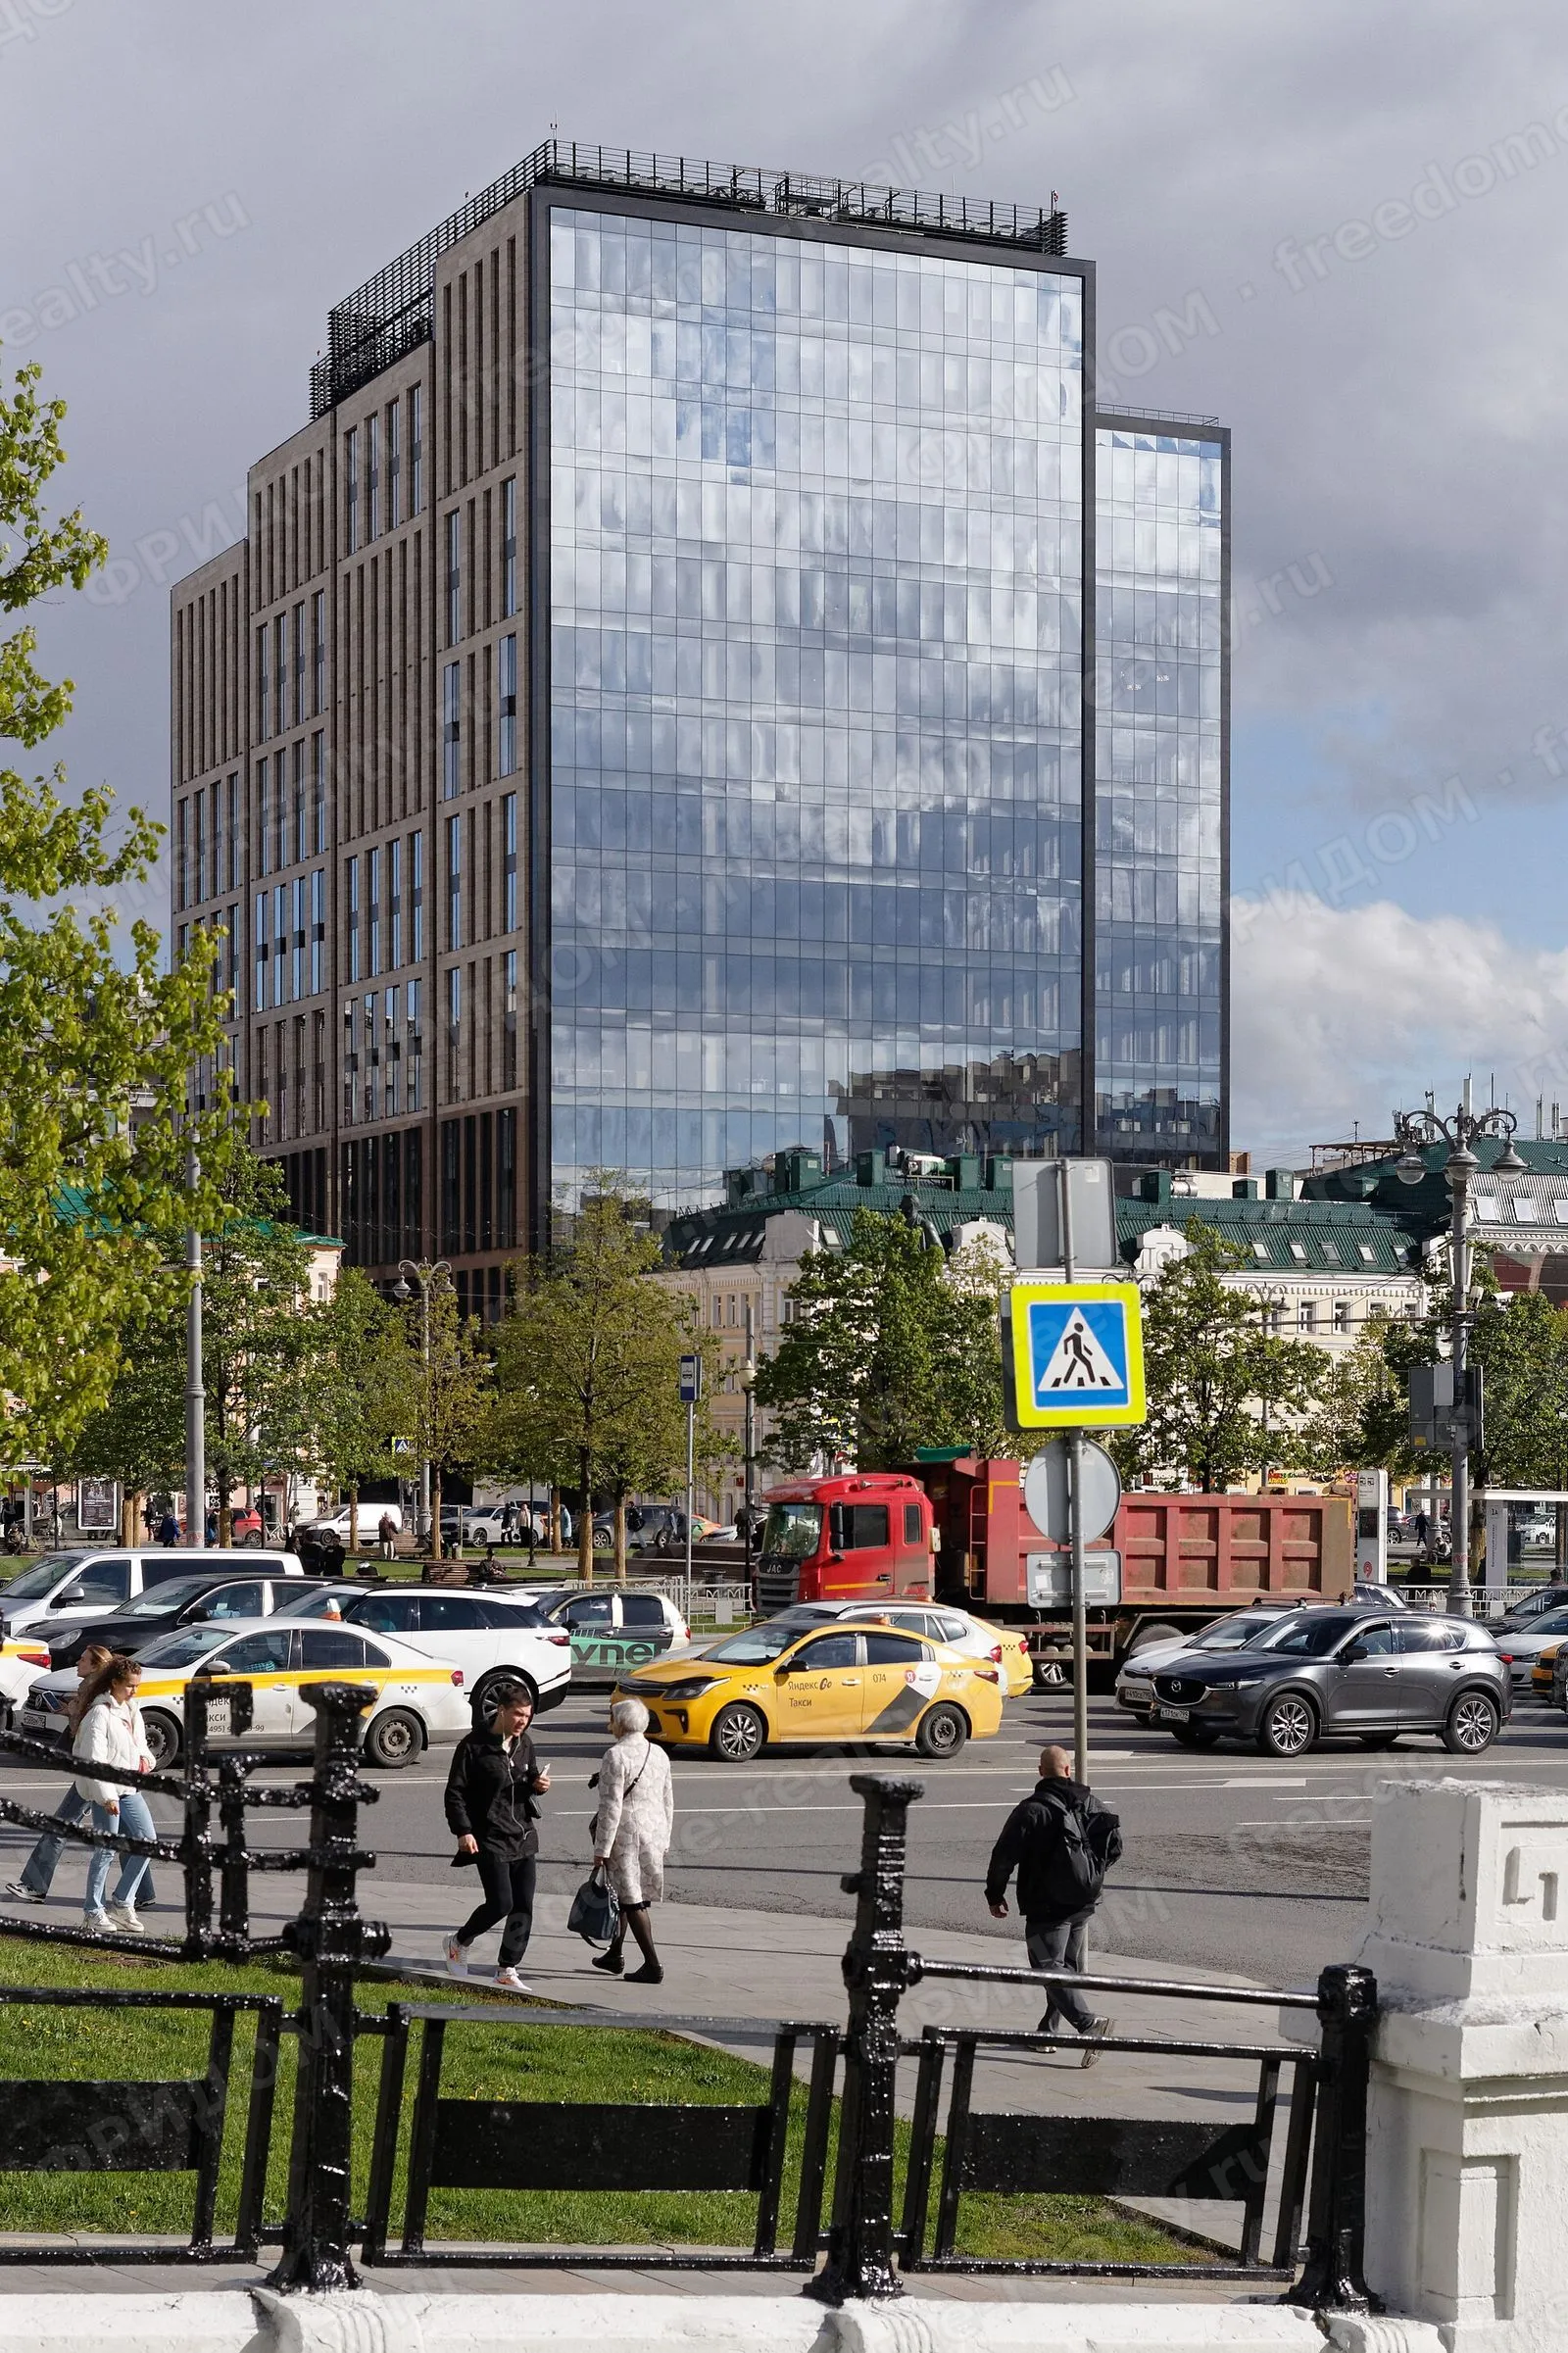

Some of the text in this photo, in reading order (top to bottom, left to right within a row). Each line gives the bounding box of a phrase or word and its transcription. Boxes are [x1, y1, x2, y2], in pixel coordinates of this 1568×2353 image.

[872, 1673, 887, 1684] 074
[788, 1680, 818, 1691] Яндекс
[788, 1697, 812, 1707] Такси
